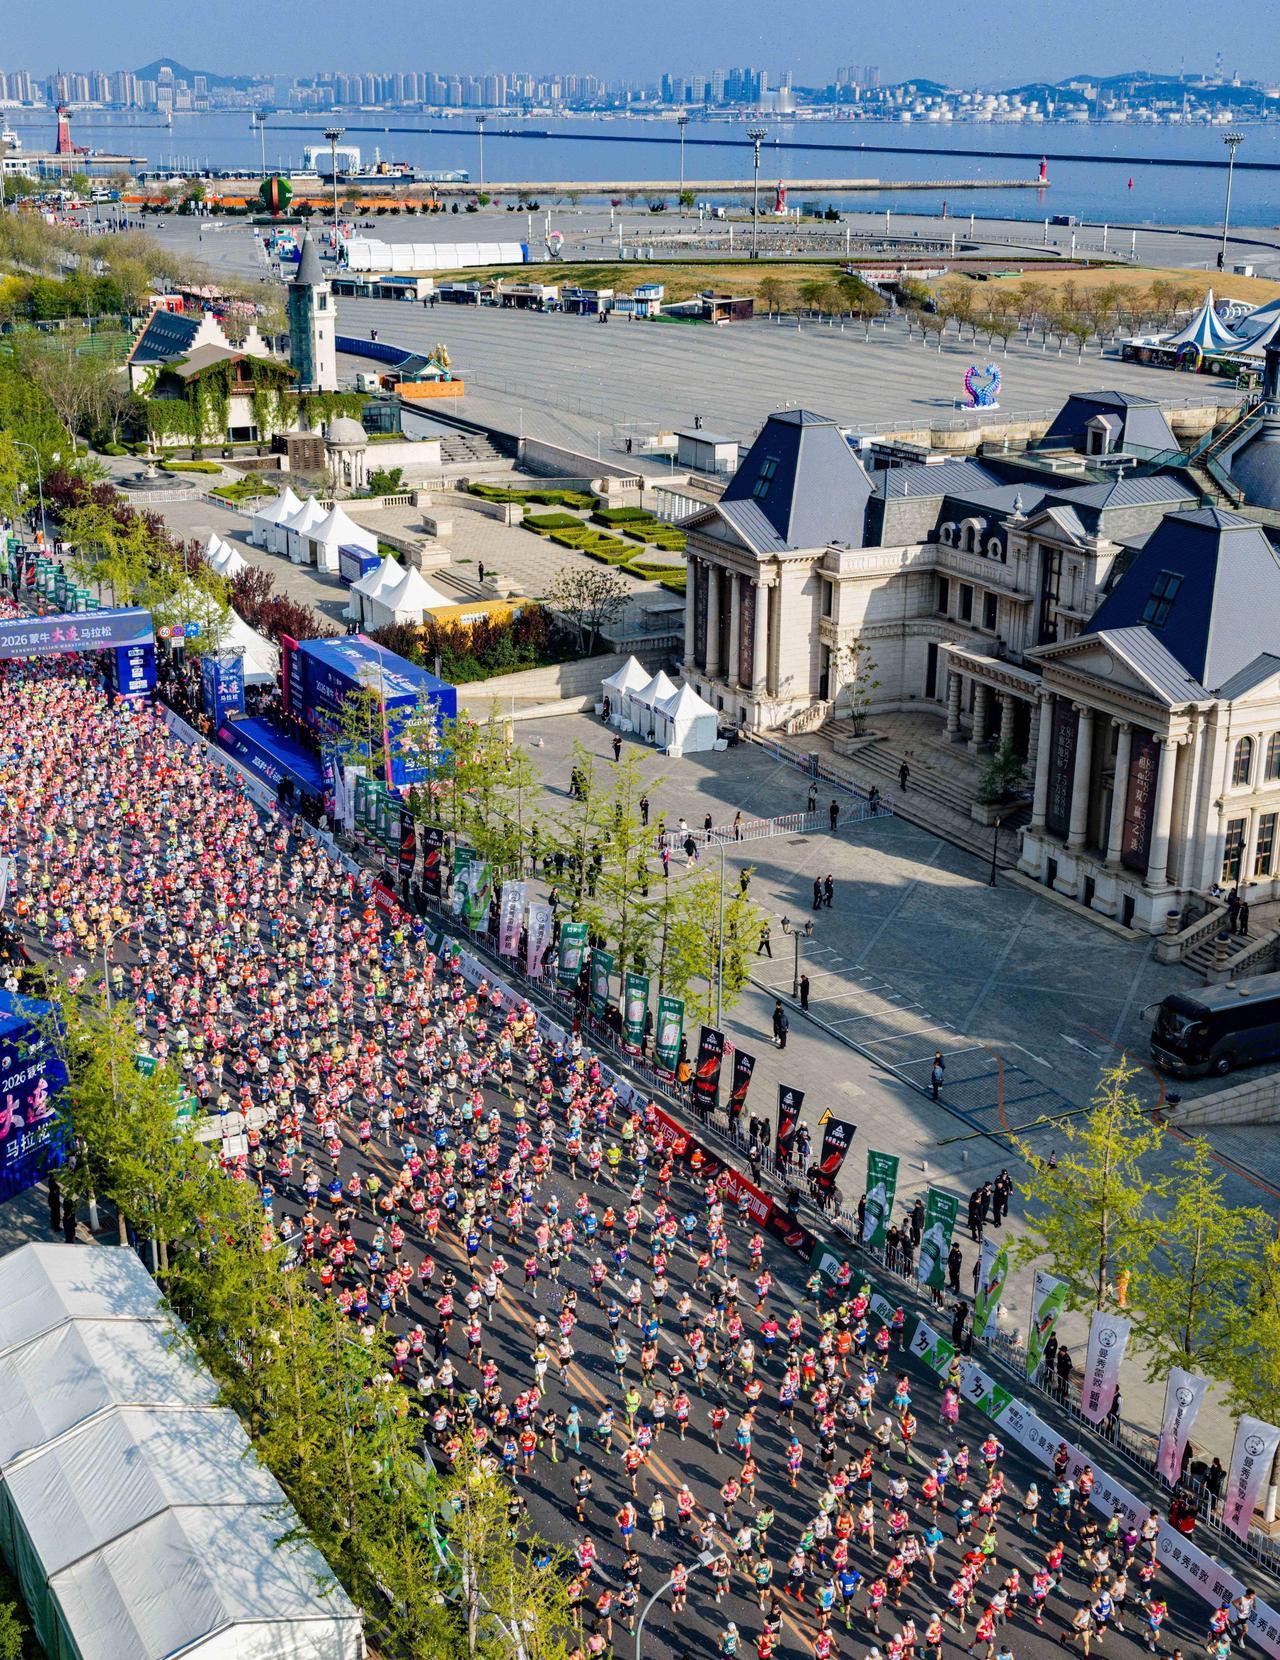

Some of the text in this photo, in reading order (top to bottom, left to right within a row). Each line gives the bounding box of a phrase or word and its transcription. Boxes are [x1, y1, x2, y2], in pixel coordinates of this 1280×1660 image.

[2, 635, 27, 647] 2026
[2, 1071, 26, 1092] 2026
[7, 1122, 51, 1157] 马拉松
[1092, 1348, 1108, 1389] 曼秀雷敦
[1238, 1456, 1254, 1501] 曼秀雷敦
[1102, 1489, 1137, 1523] 曼秀雷敦
[1171, 1548, 1234, 1603] 曼秀雷敦 新碧
